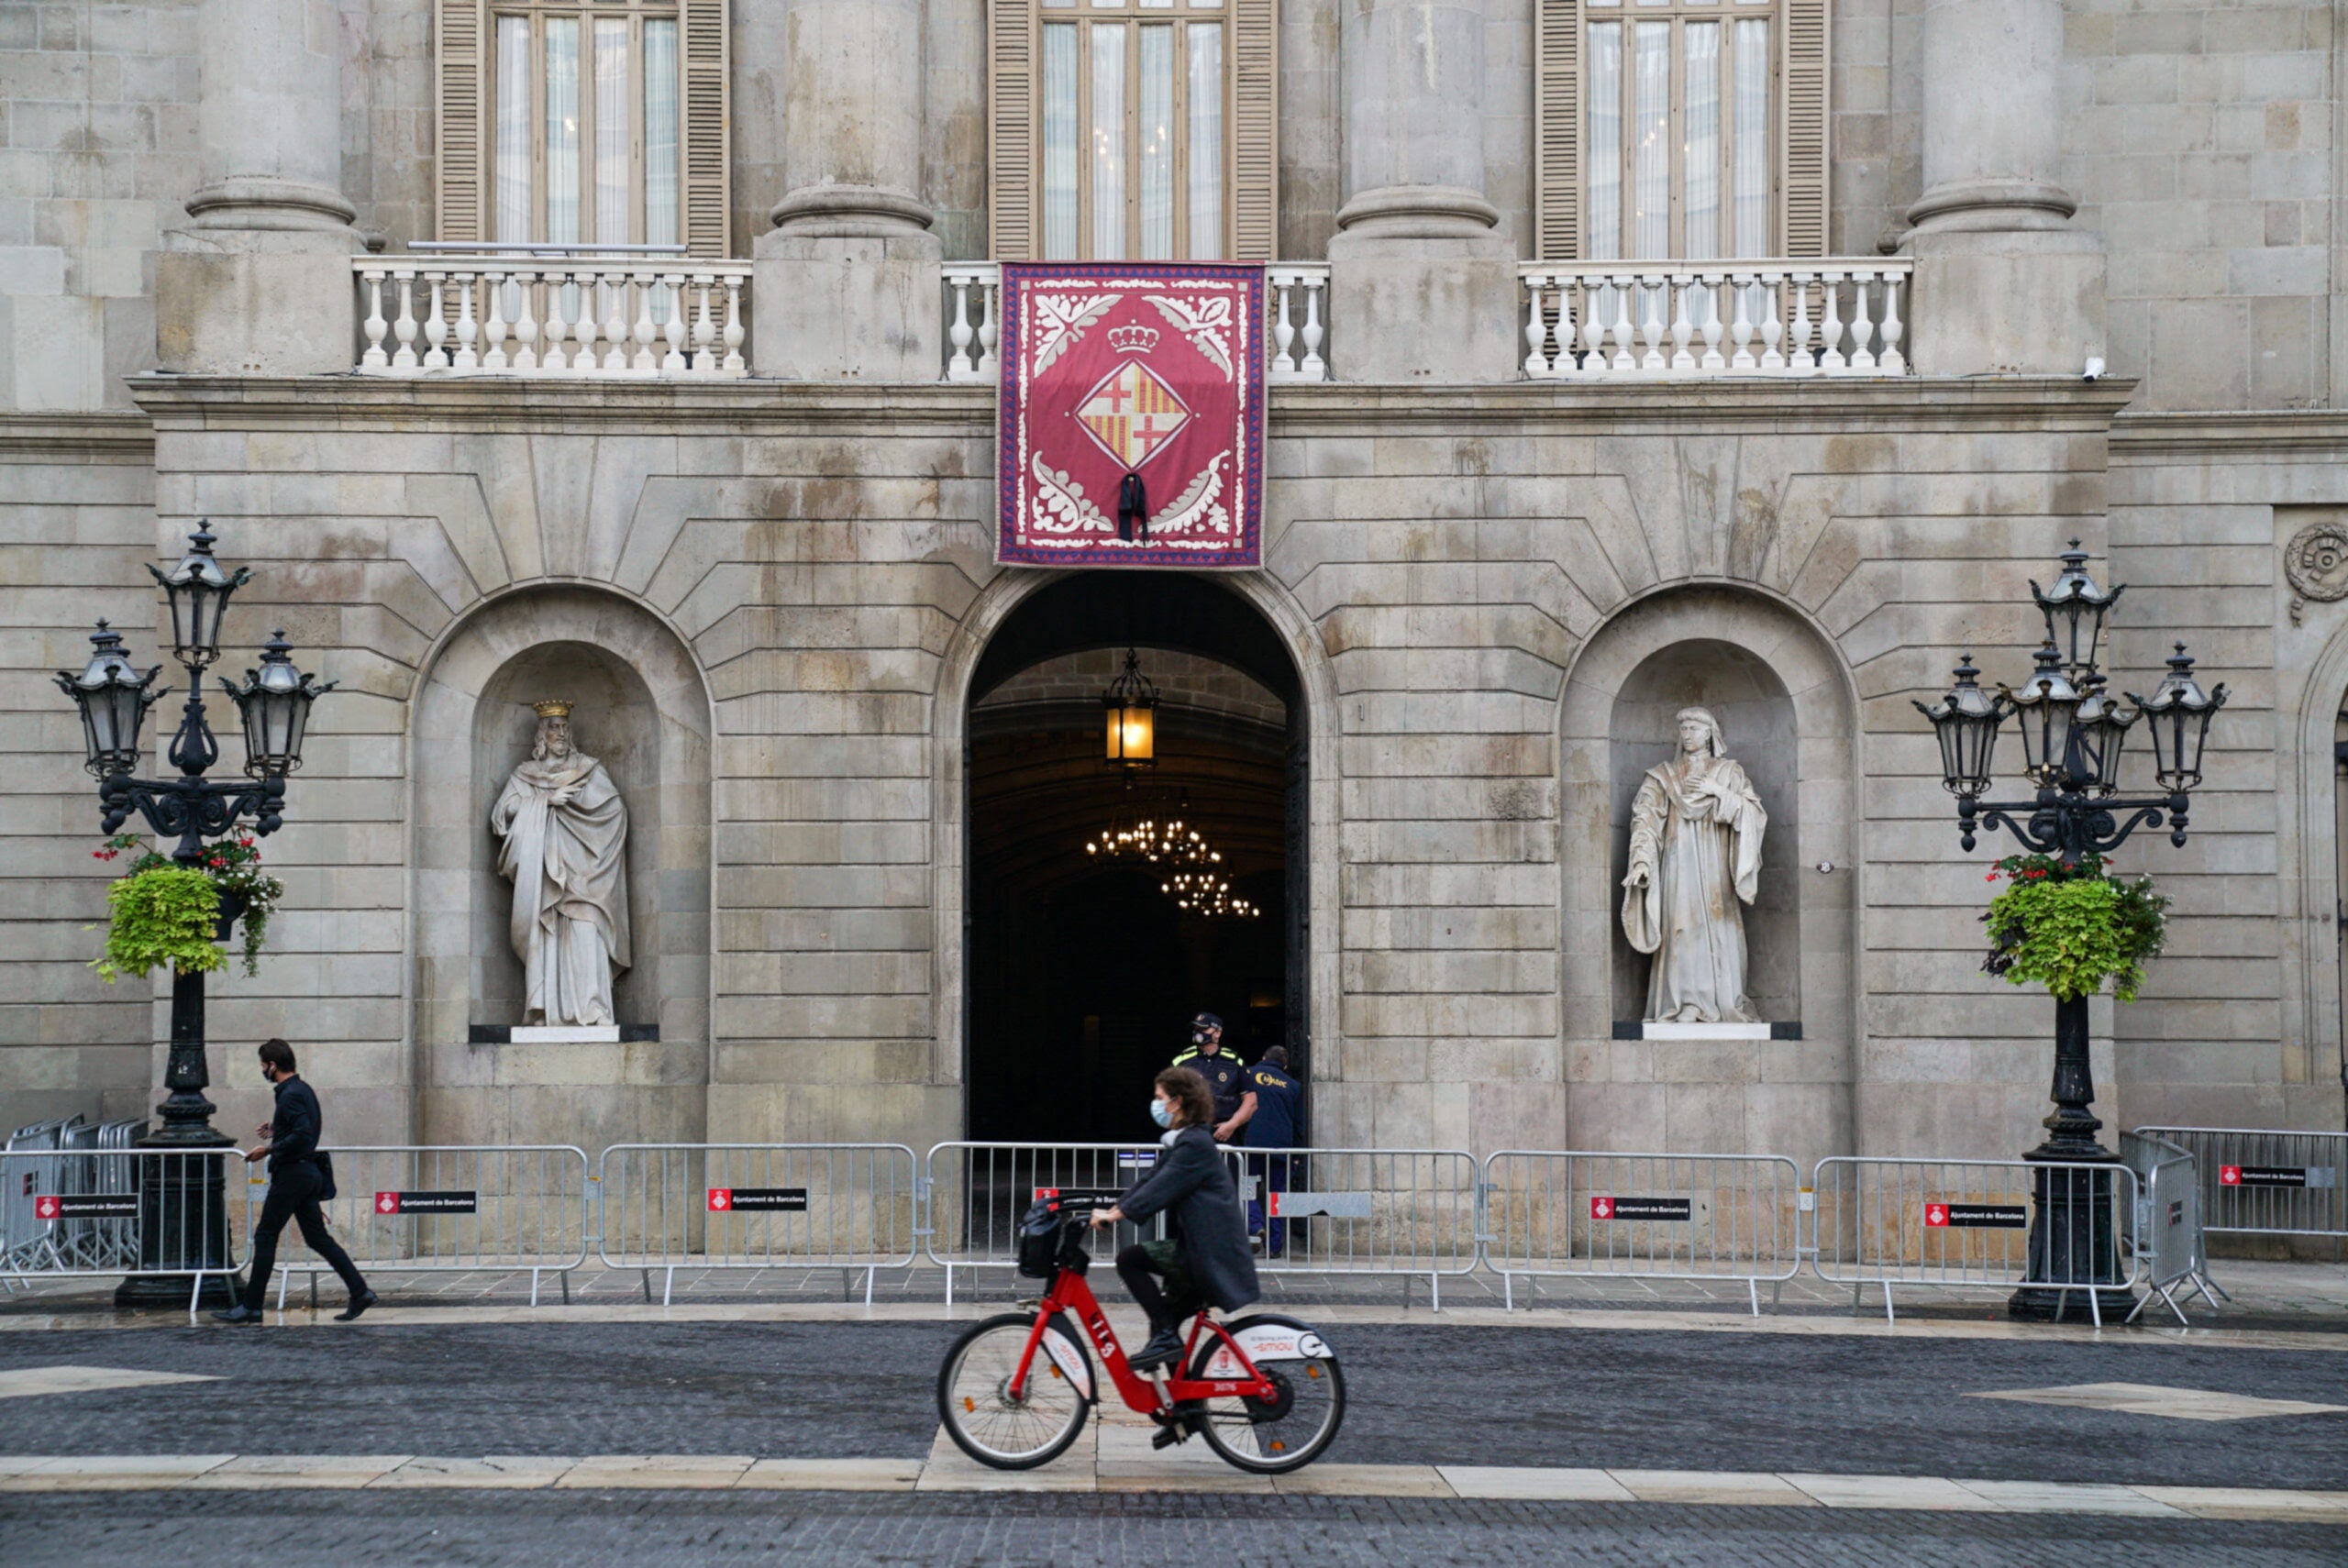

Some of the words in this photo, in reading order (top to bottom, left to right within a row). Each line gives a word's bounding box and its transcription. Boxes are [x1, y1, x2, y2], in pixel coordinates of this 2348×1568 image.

[61, 1203, 96, 1211] Ajuntament
[1615, 1205, 1650, 1213] Ajuntament
[1950, 1211, 1985, 1220] Ajuntament
